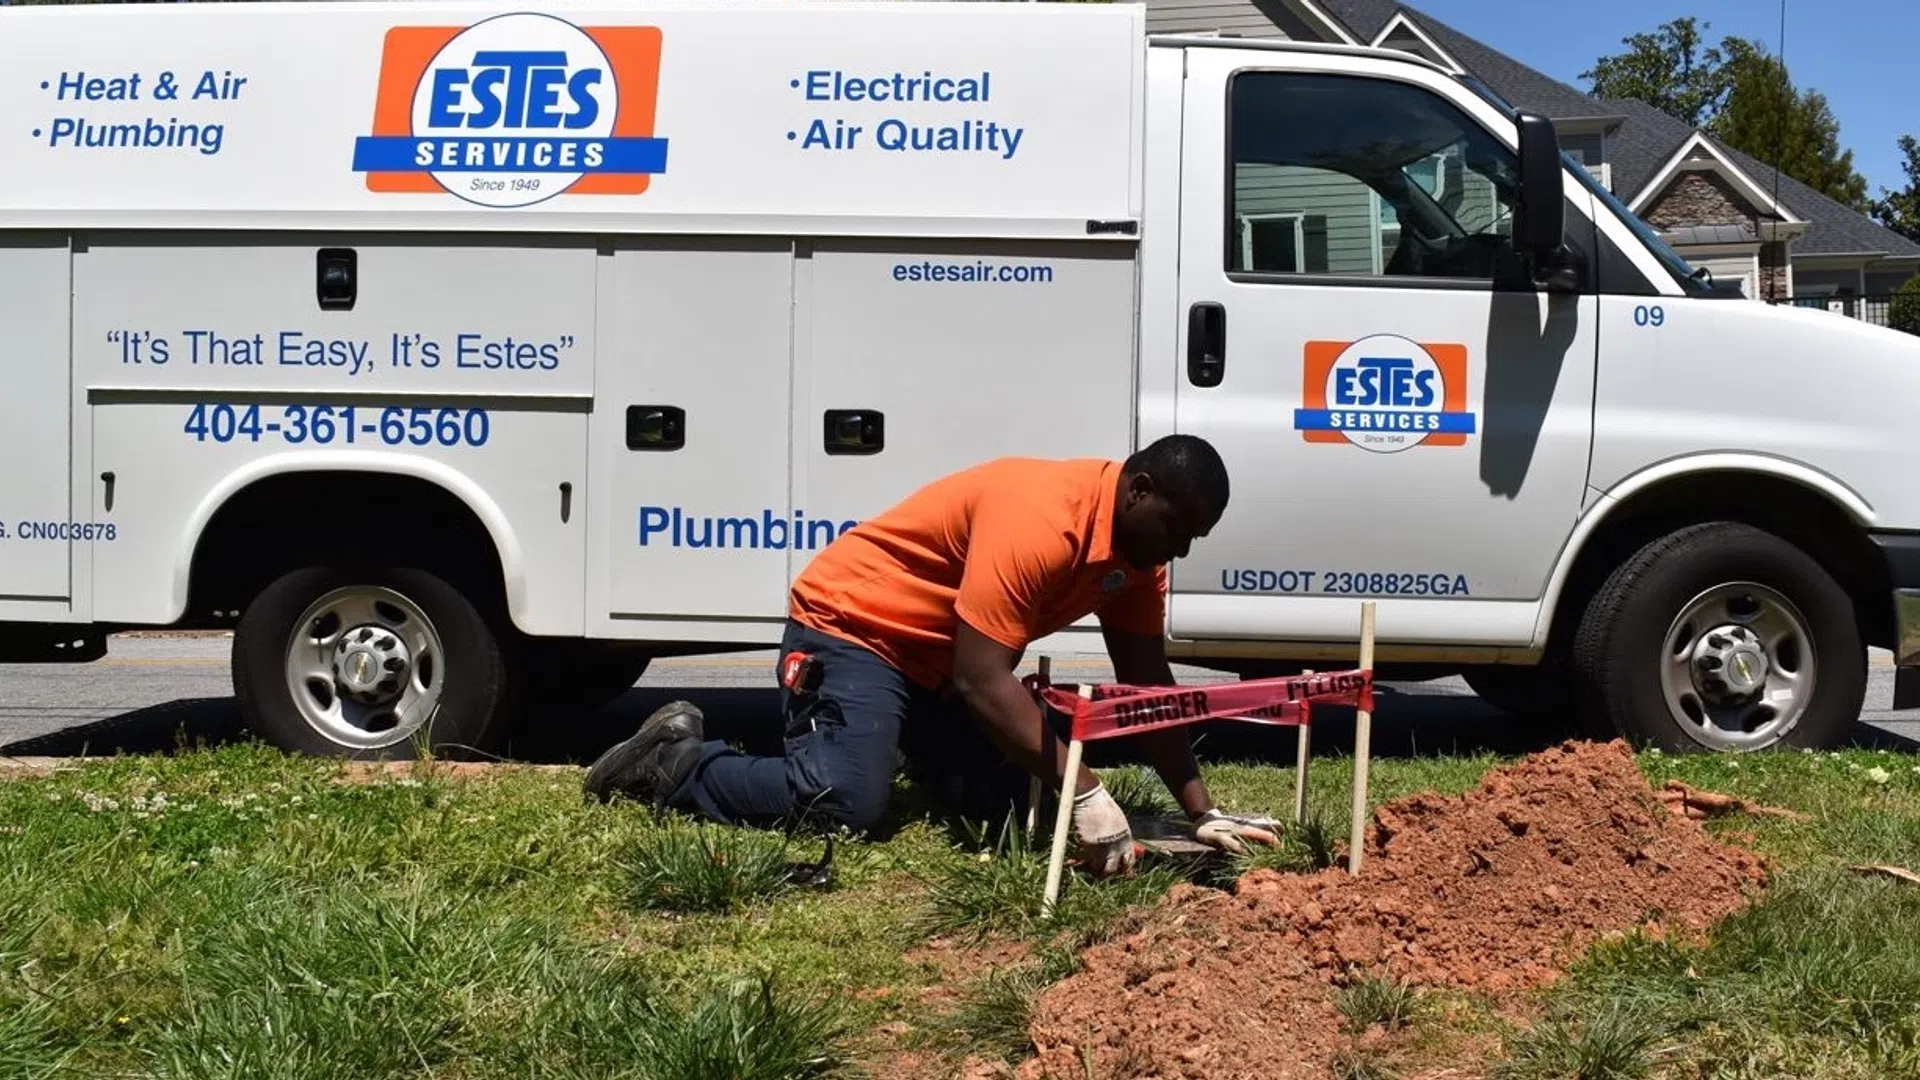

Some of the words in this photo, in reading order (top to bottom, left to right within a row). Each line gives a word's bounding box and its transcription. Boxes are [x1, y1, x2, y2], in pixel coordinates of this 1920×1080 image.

[56, 71, 142, 101] Heat
[152, 71, 179, 101] &
[191, 71, 248, 101] Air
[427, 51, 603, 129] ESTES
[805, 70, 991, 103] Electrical
[49, 118, 225, 156] Plumbing
[801, 118, 863, 151] Air
[875, 119, 1024, 160] Quality
[415, 141, 605, 167] SERVICES
[470, 178, 505, 191] Since
[510, 178, 541, 191] 1949
[891, 260, 1054, 283] estesair.com
[1633, 305, 1665, 328] 09
[182, 331, 264, 366] That
[278, 332, 375, 376] Easy,
[392, 333, 441, 369] It’s
[1335, 357, 1435, 407] ESTES
[184, 404, 491, 448] 404-361-6560
[1330, 412, 1440, 429] SERVICES
[17, 521, 117, 541] CN003678
[1221, 569, 1316, 593] USDOT
[1323, 571, 1470, 597] 2308825GA
[1114, 690, 1210, 729] DANGER
